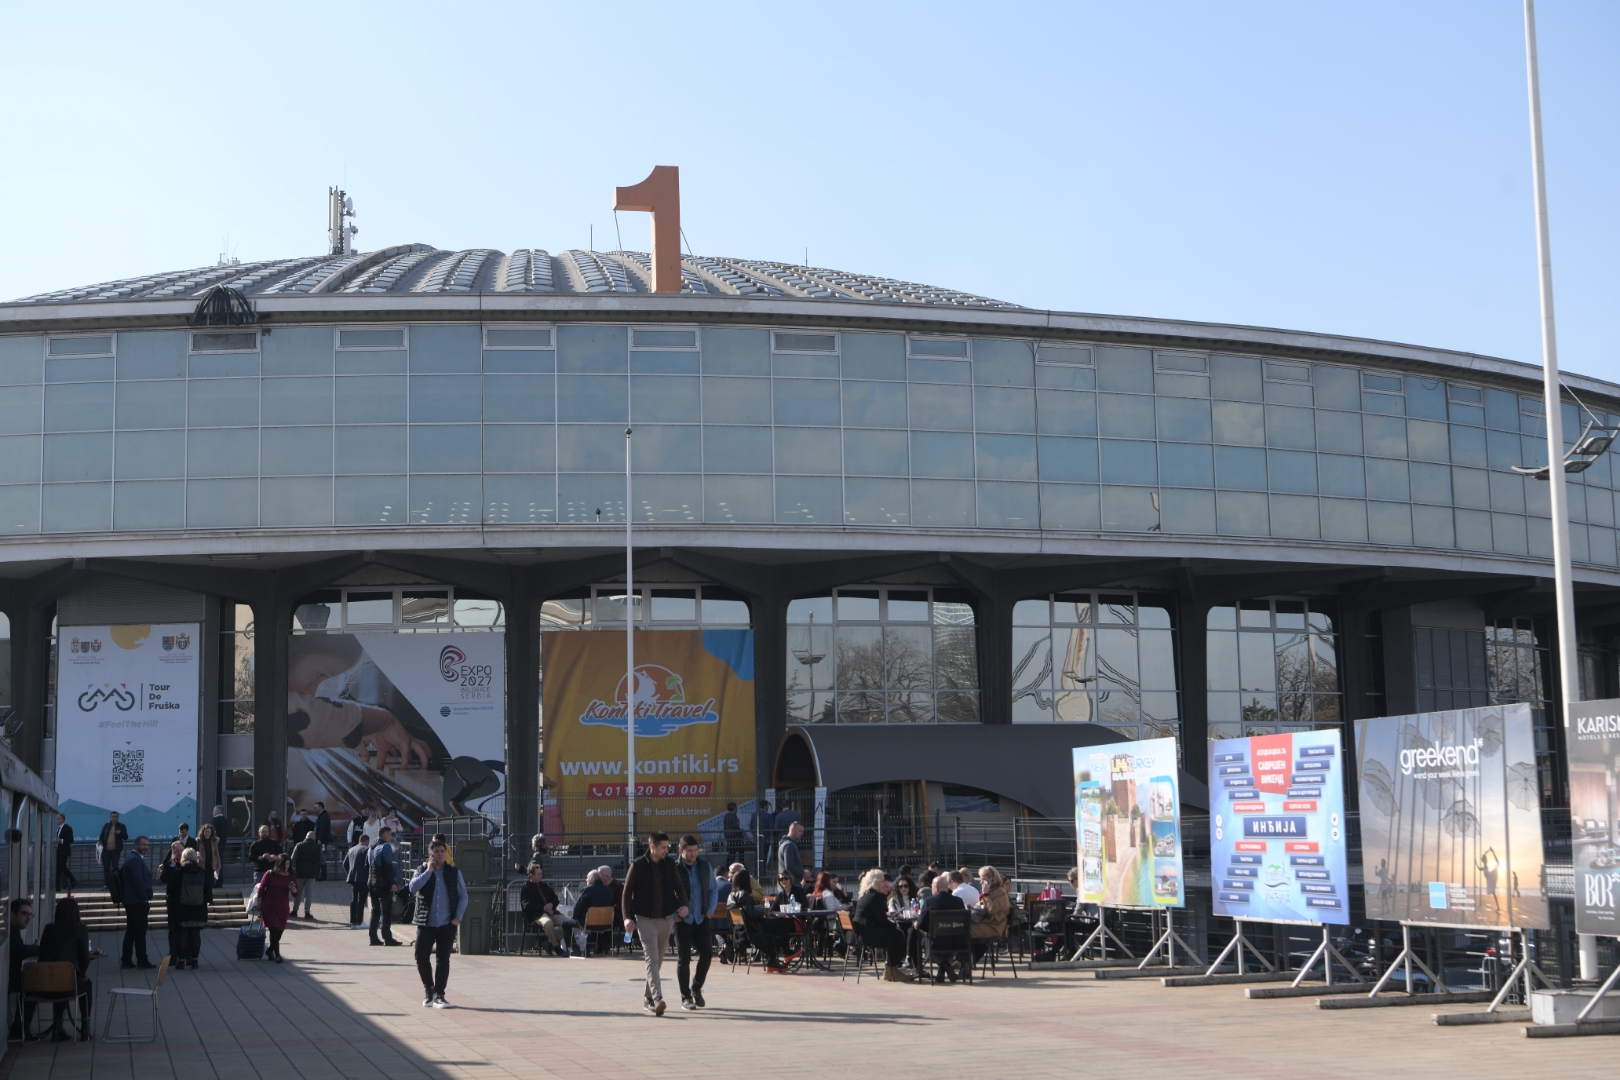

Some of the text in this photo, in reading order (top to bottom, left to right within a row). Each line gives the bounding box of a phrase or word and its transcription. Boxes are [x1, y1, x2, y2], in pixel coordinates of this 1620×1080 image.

[612, 165, 681, 294] 1
[460, 665, 492, 676] EXPO
[149, 683, 171, 691] Tour
[460, 676, 492, 687] 2027
[149, 701, 180, 710] Fruška
[655, 699, 713, 719] Travel
[98, 720, 159, 728] #FeelTheHill
[559, 754, 739, 776] www.kontiki.rs
[1128, 757, 1156, 769] TURKEY
[1258, 760, 1286, 771] САВРШЕН
[1260, 773, 1285, 785] ВИКЕНД
[636, 785, 653, 796] 20
[658, 785, 675, 795] 98
[681, 784, 707, 795] 000
[655, 807, 711, 816] kontiki.travel
[1252, 820, 1297, 833] ИНЂИЈА
[1264, 892, 1291, 905] ИНЂИЈА
